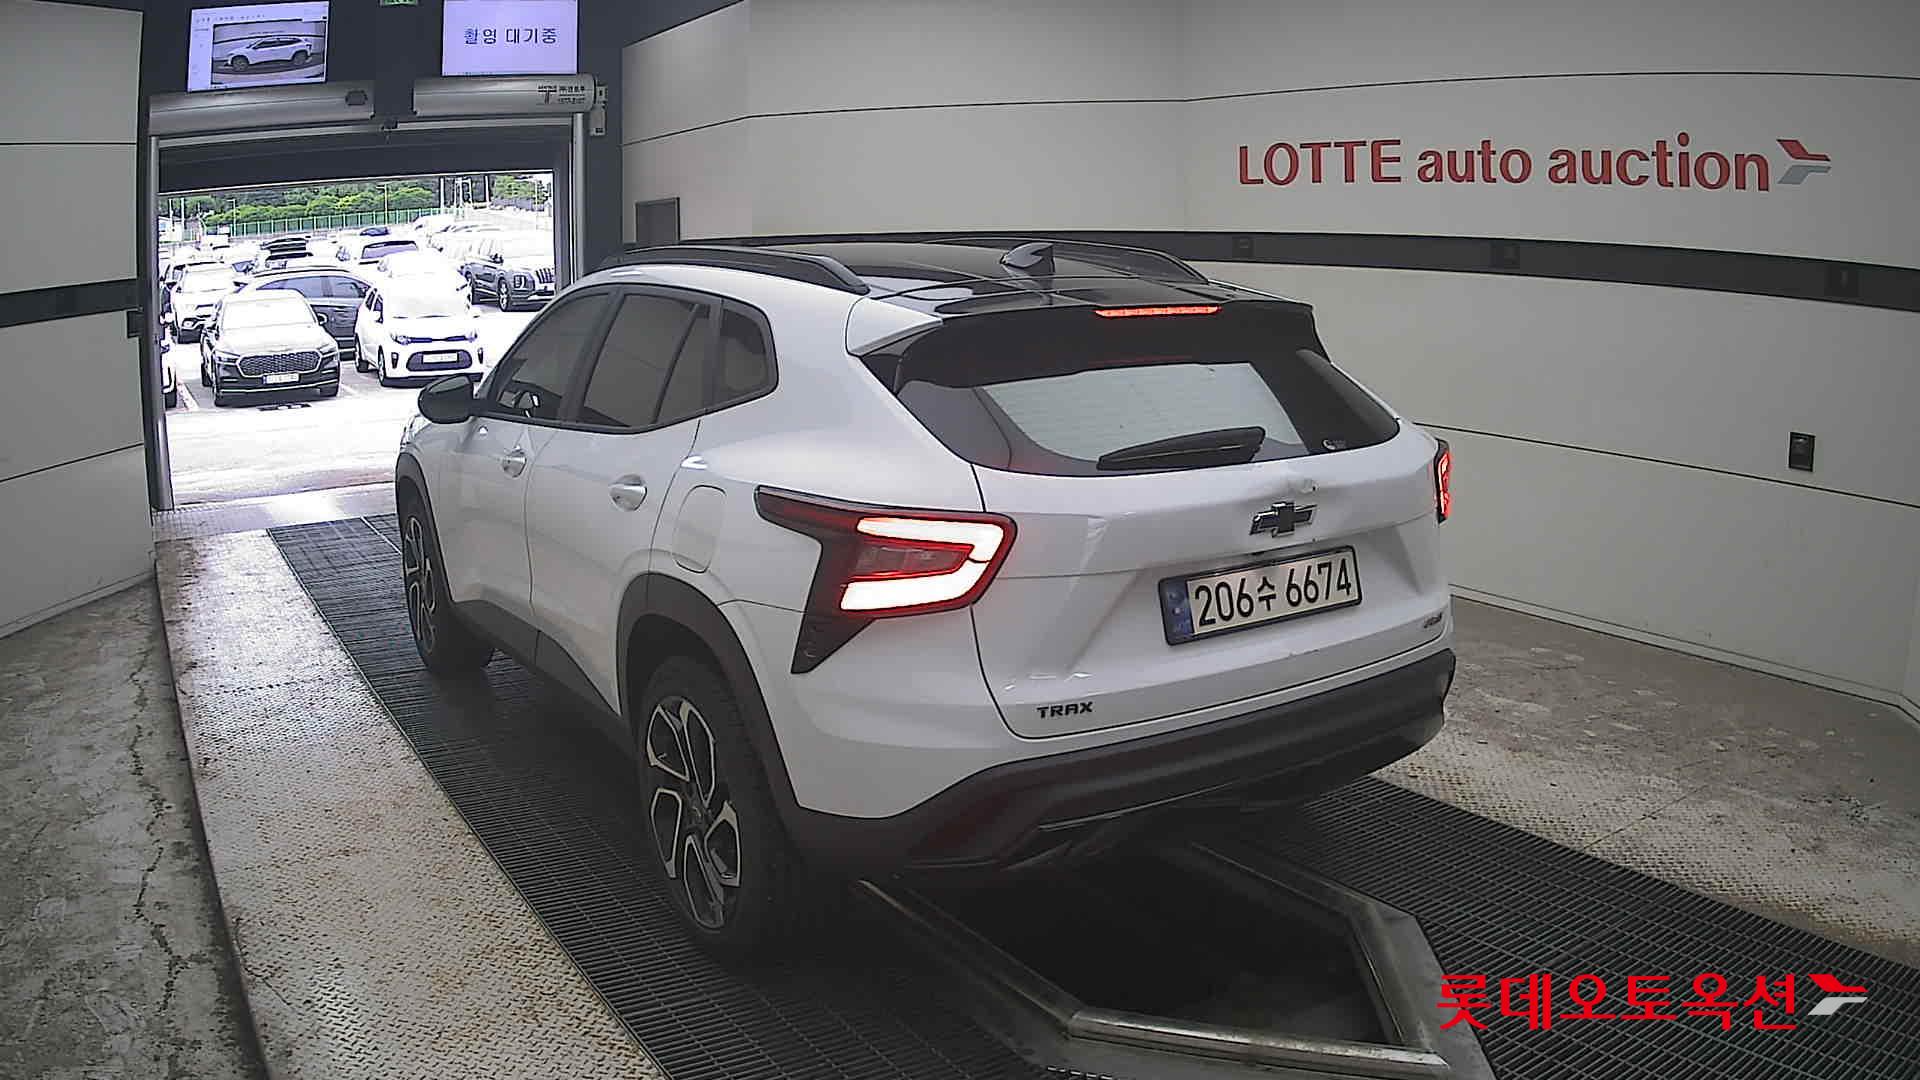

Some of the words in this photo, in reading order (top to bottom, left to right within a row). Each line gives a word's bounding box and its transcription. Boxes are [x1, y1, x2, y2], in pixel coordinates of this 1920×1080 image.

[506, 28, 557, 44] 대기중
[1239, 139, 1401, 185] LOTTE
[1417, 141, 1532, 184] auto
[1547, 132, 1770, 192] auction
[1194, 576, 1277, 627] 206수
[1285, 557, 1352, 608] 6674
[1037, 701, 1094, 719] TRAX
